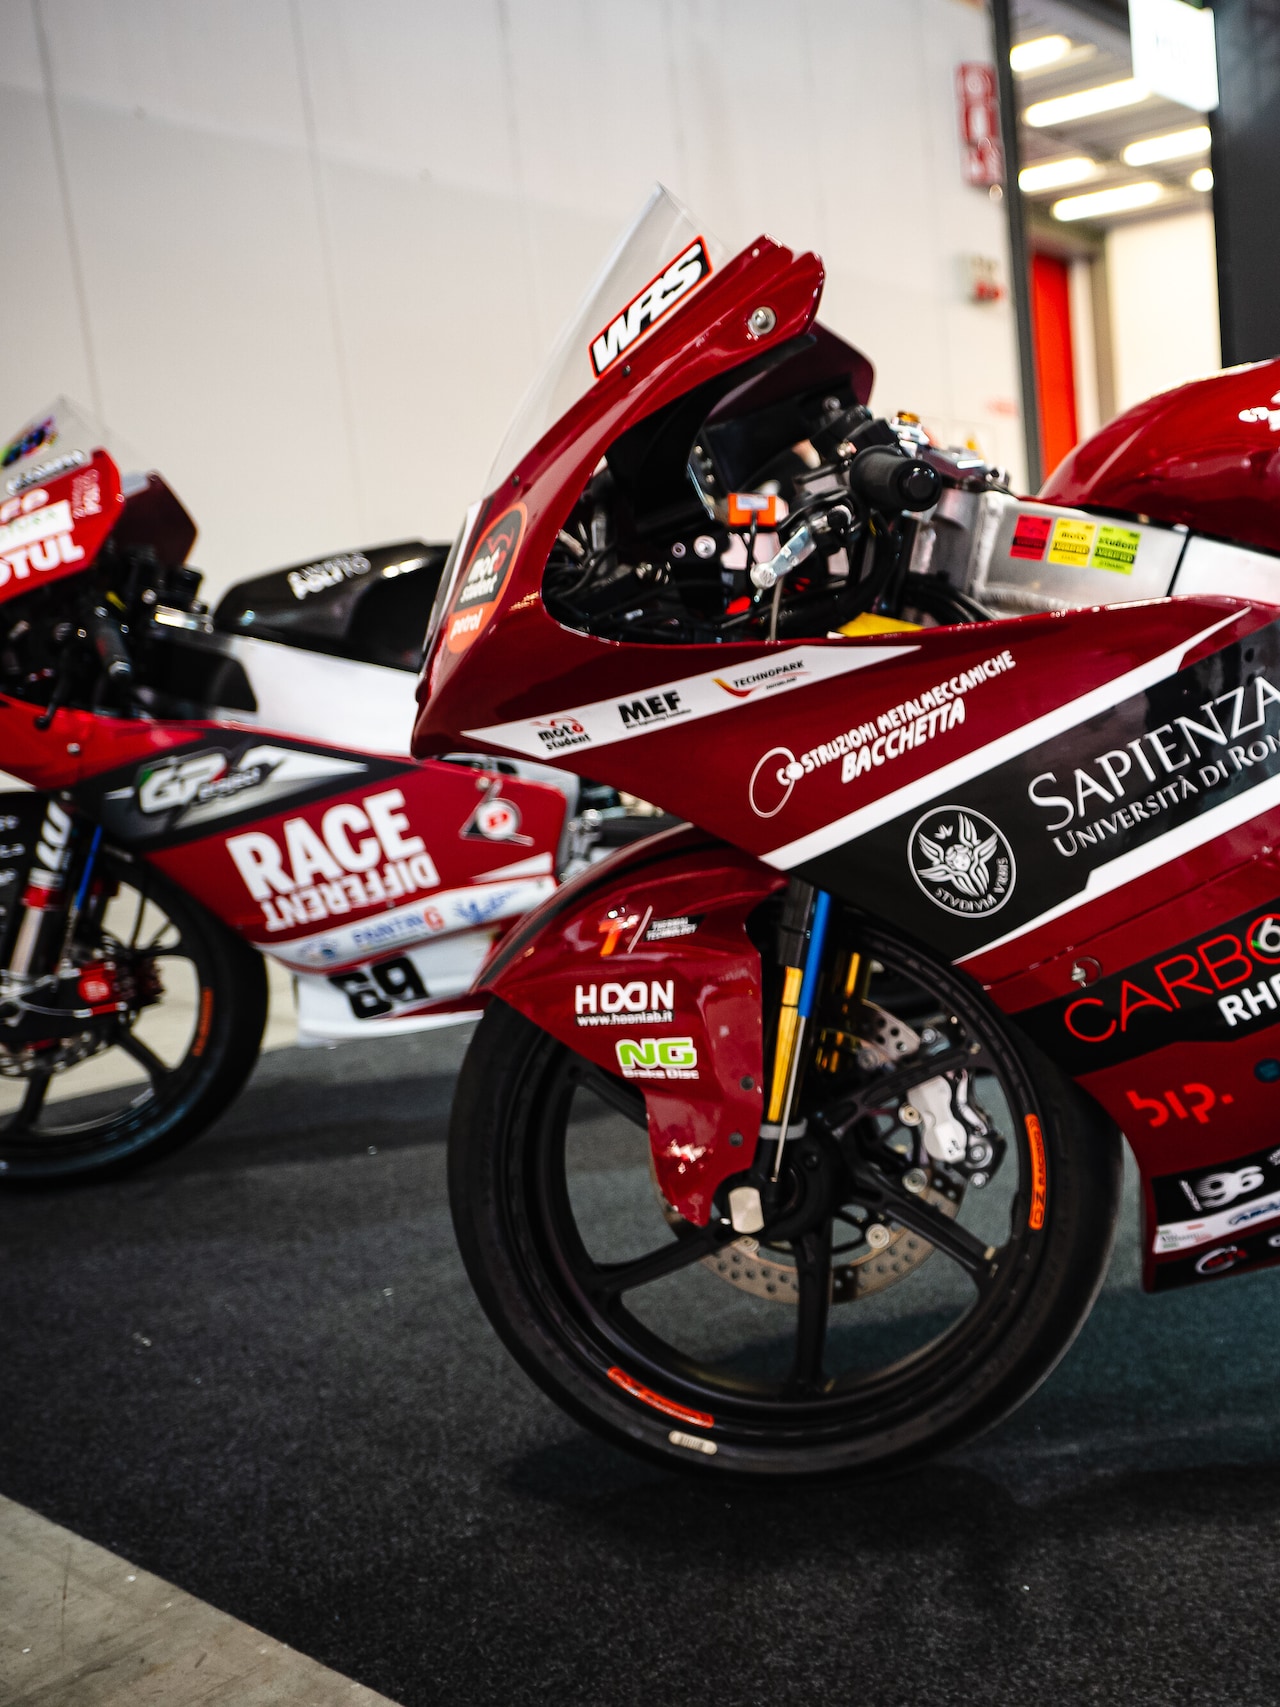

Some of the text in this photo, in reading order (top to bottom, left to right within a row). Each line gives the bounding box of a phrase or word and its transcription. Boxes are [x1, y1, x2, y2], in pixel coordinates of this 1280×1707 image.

[593, 243, 702, 373] WRS
[733, 659, 805, 689] TECHNOPARK
[877, 650, 1016, 734] METALMECCANICHE
[617, 689, 682, 725] MEF
[546, 734, 592, 751] student
[841, 697, 966, 784] BACCHETTA
[1199, 759, 1229, 788] DI
[225, 788, 426, 901] RACE
[259, 851, 441, 932] DIFFERENT
[577, 1009, 674, 1026] www.hoonlab.it
[616, 1037, 697, 1068] NG
